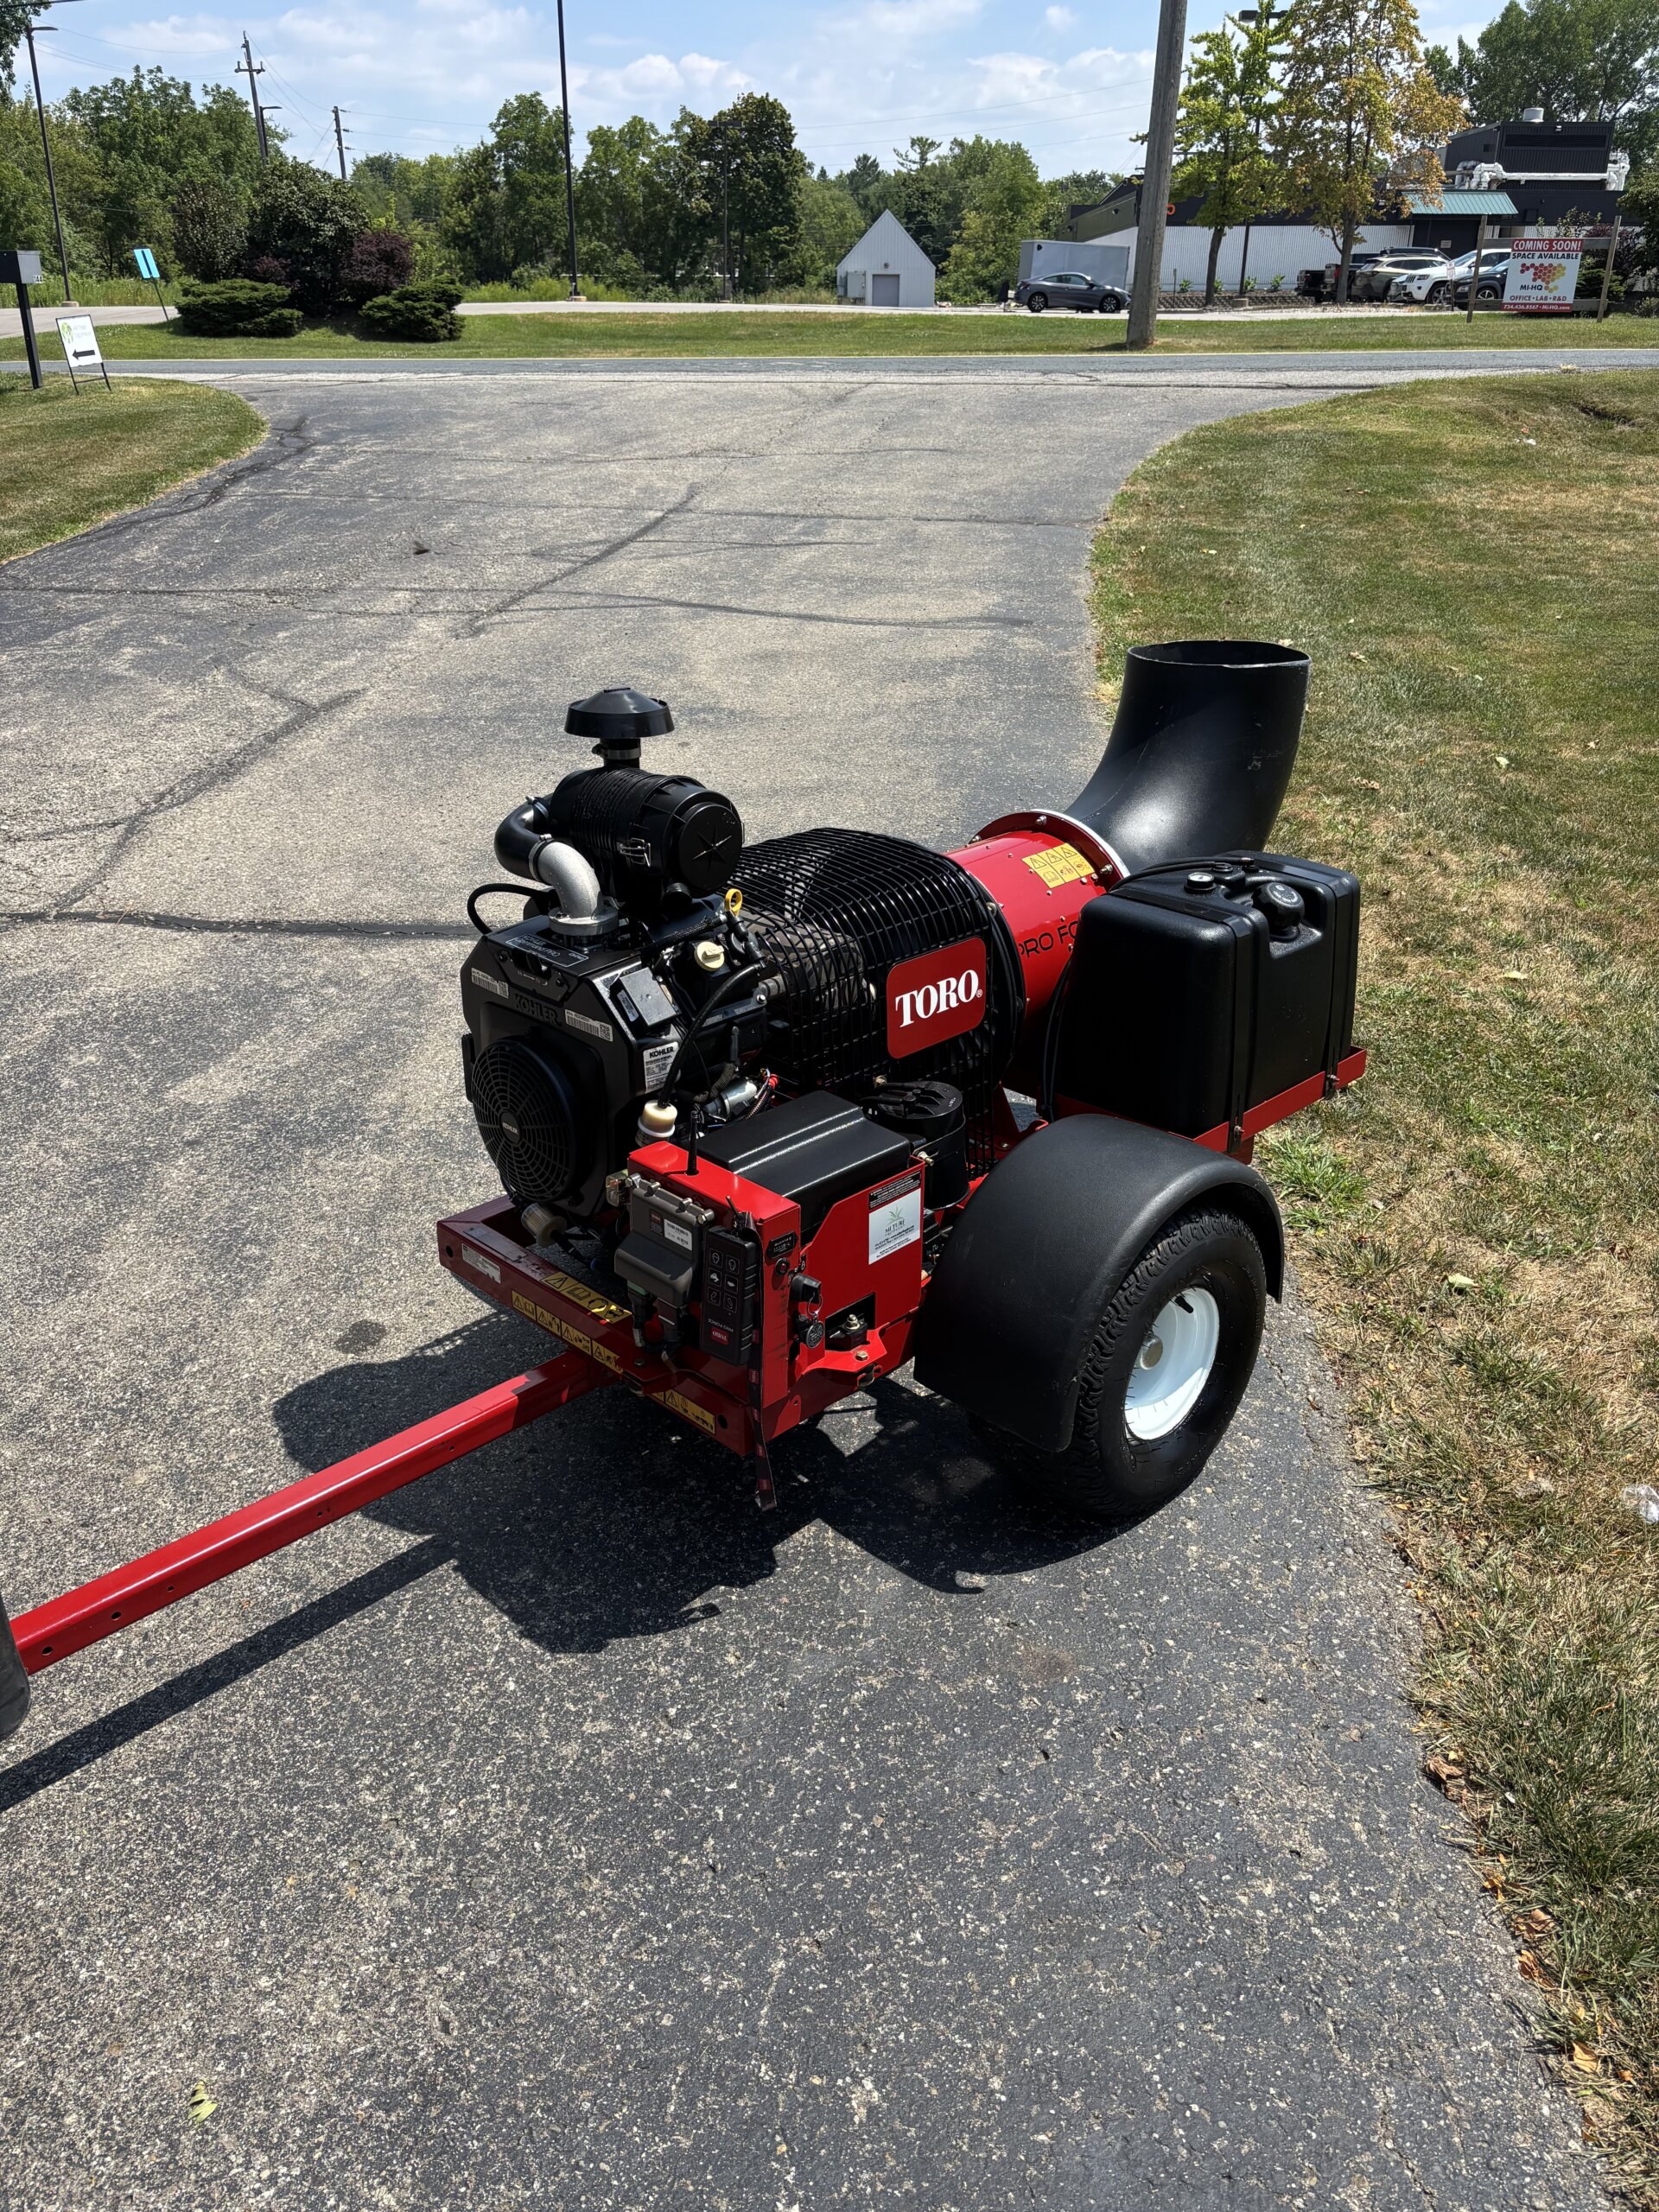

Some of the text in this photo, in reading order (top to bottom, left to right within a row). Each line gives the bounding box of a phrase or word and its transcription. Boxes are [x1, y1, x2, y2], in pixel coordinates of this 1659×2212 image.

[1514, 241, 1581, 251] COMING SOON!
[512, 993, 561, 1026] KOHLER
[649, 1046, 675, 1058] KOHLER
